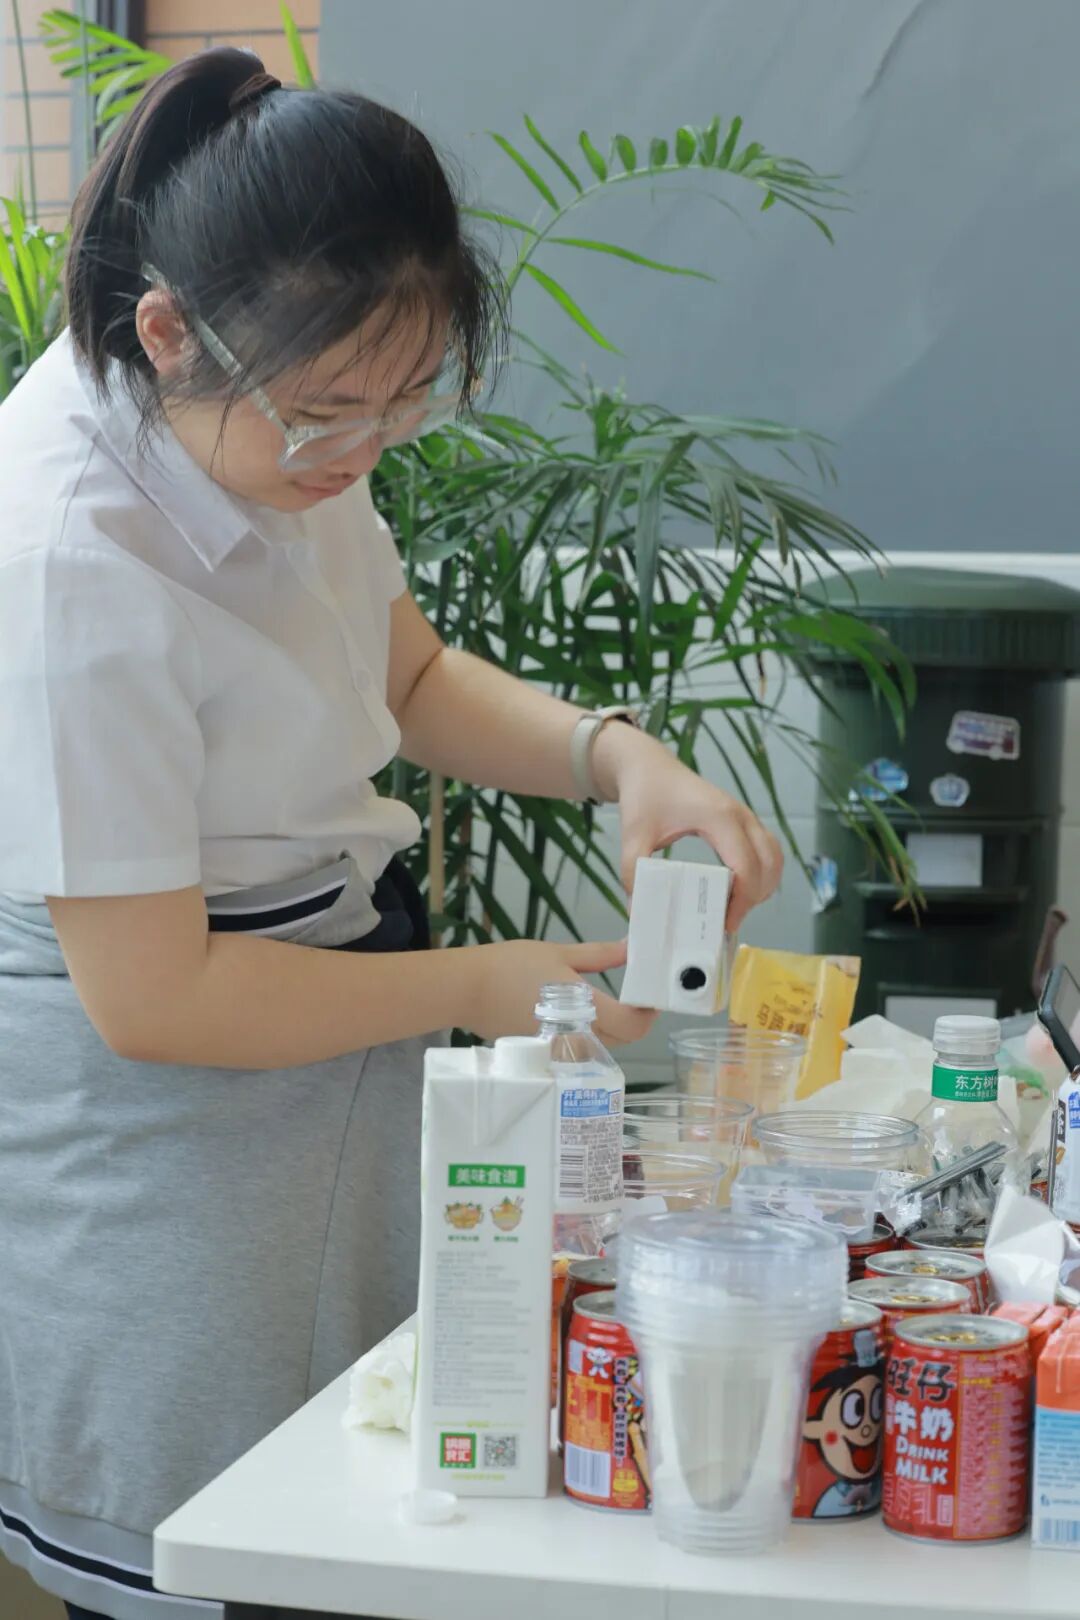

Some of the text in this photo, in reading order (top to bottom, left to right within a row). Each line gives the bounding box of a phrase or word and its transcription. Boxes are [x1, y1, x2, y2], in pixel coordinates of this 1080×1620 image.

[895, 1400, 955, 1442] 牛奶
[896, 1436, 949, 1462] DRINK
[895, 1456, 948, 1484] MILK
